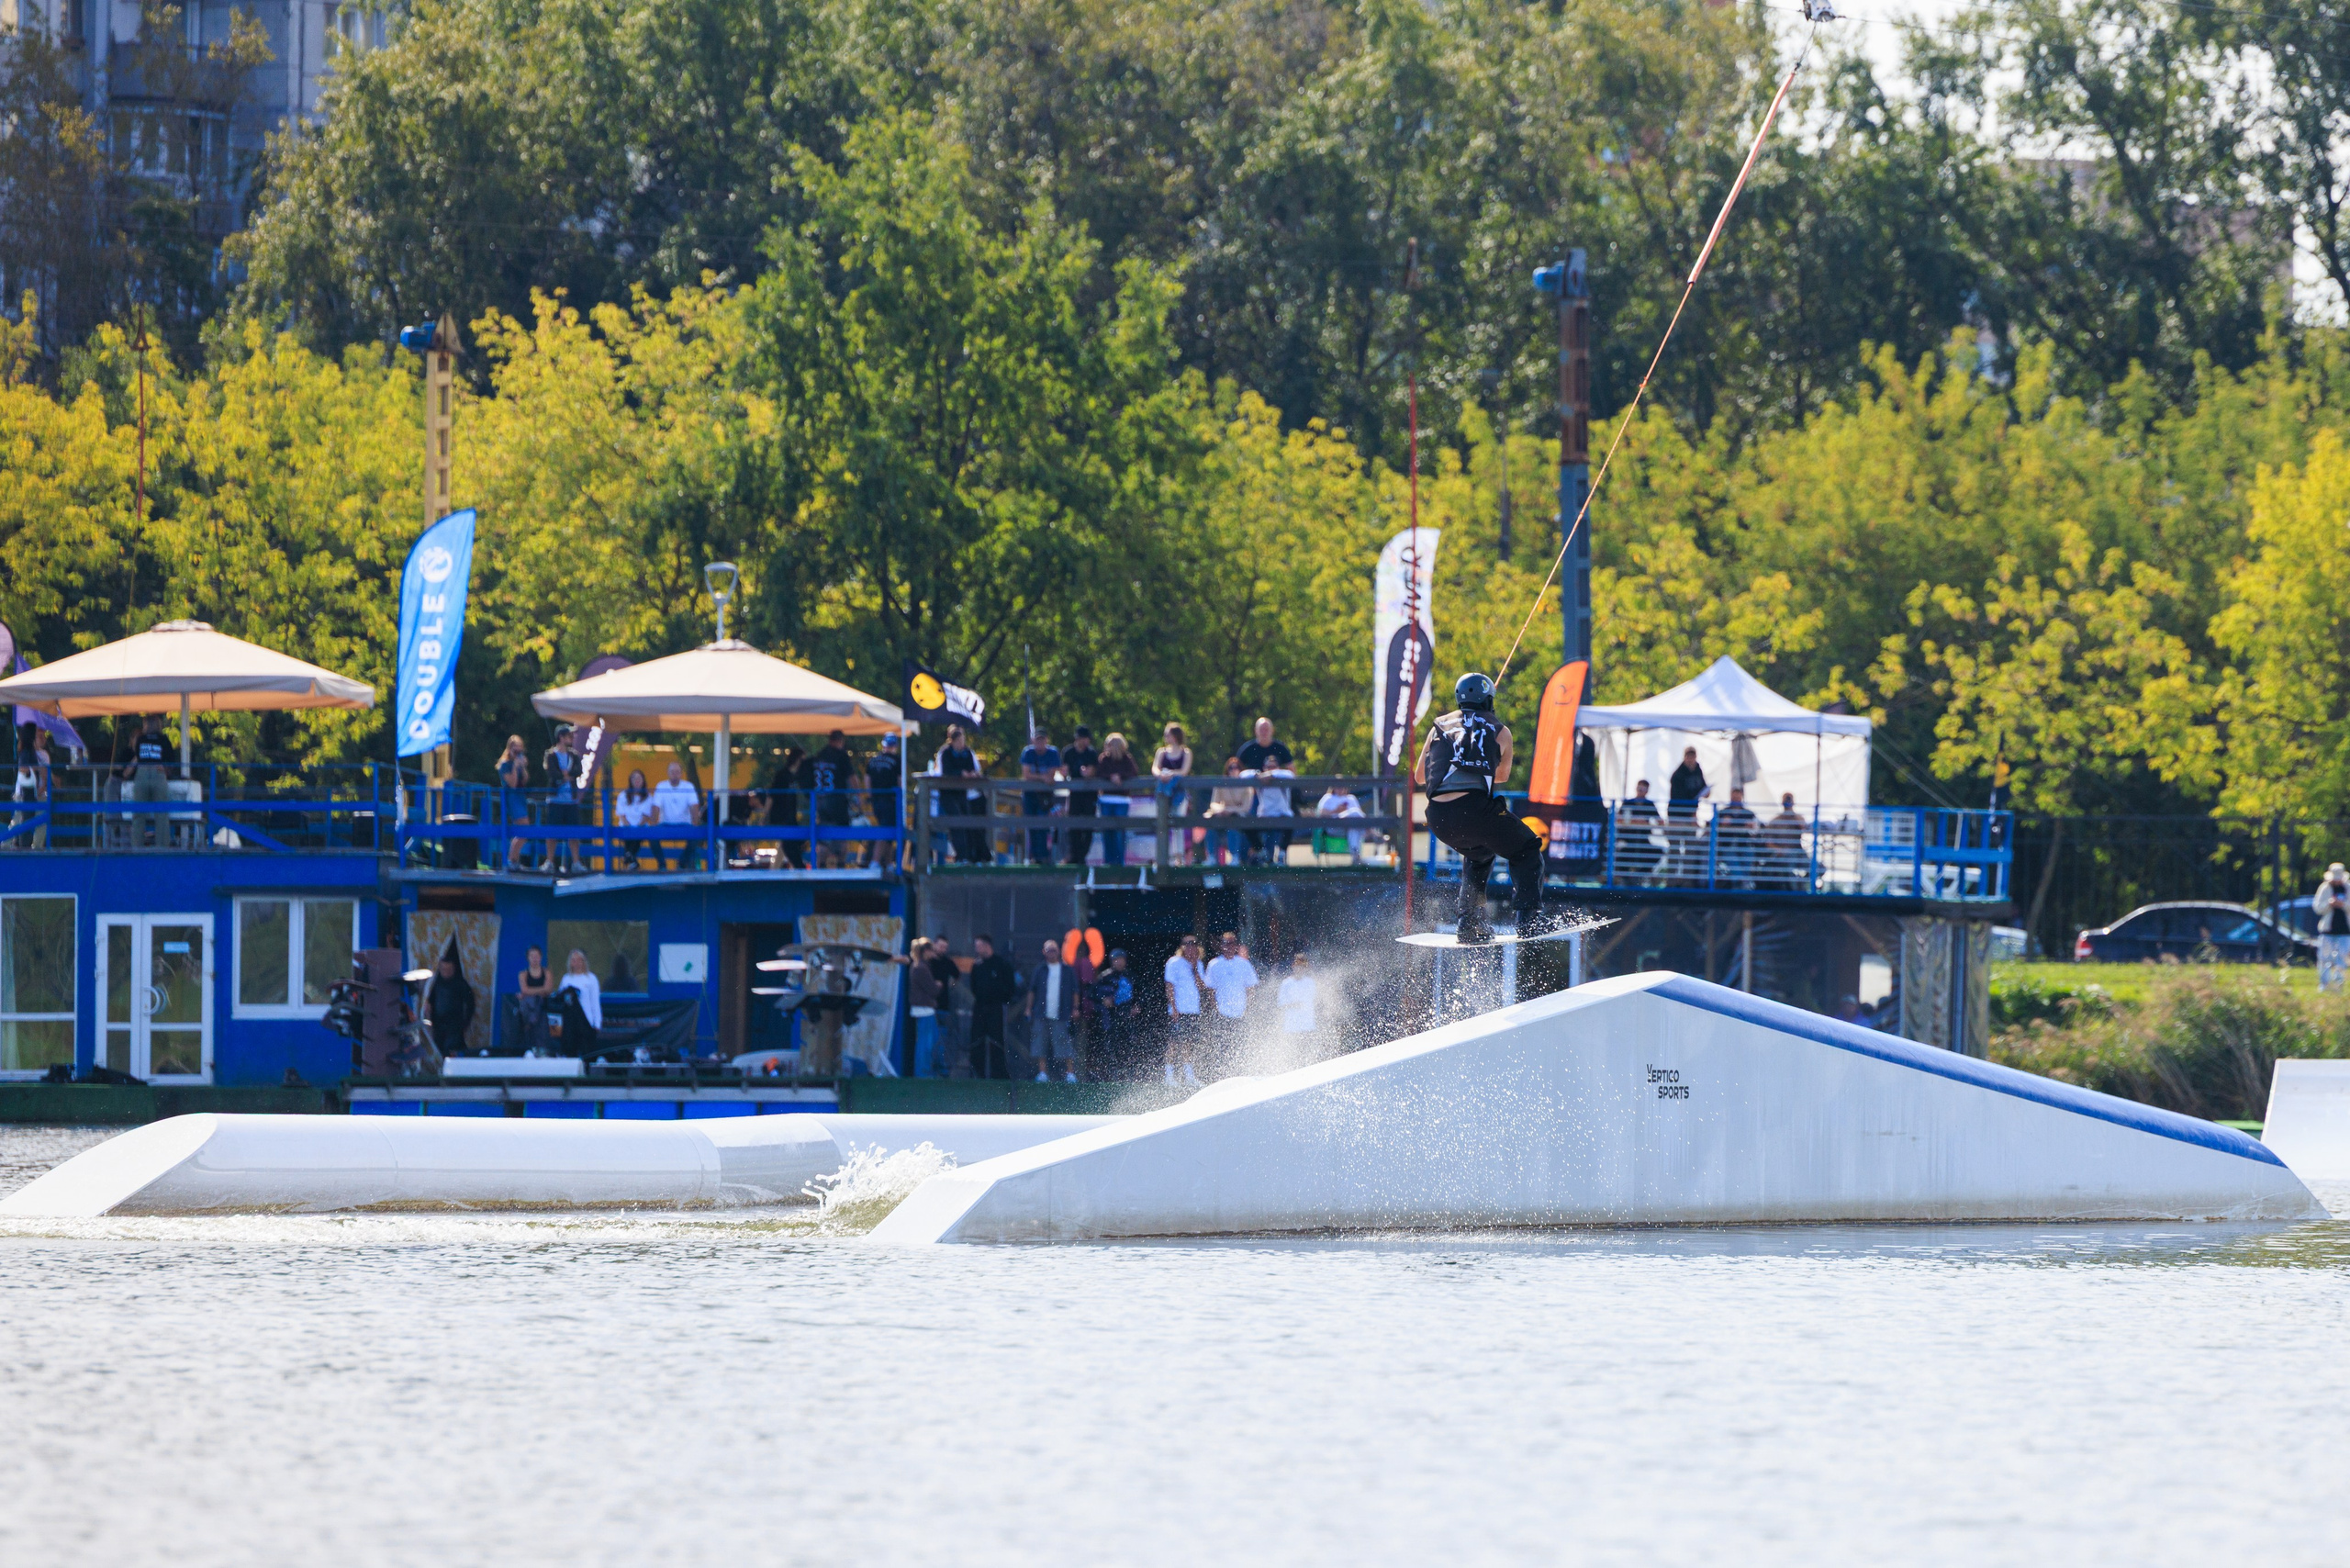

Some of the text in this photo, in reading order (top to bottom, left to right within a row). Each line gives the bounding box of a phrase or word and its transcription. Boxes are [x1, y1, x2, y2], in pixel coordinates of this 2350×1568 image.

[409, 593, 445, 740] DOUBLE
[1394, 686, 1411, 725] ZONE
[1387, 725, 1405, 766] COOL
[1550, 820, 1603, 842] DIRTY
[1658, 1086, 1689, 1099] SPORTS
